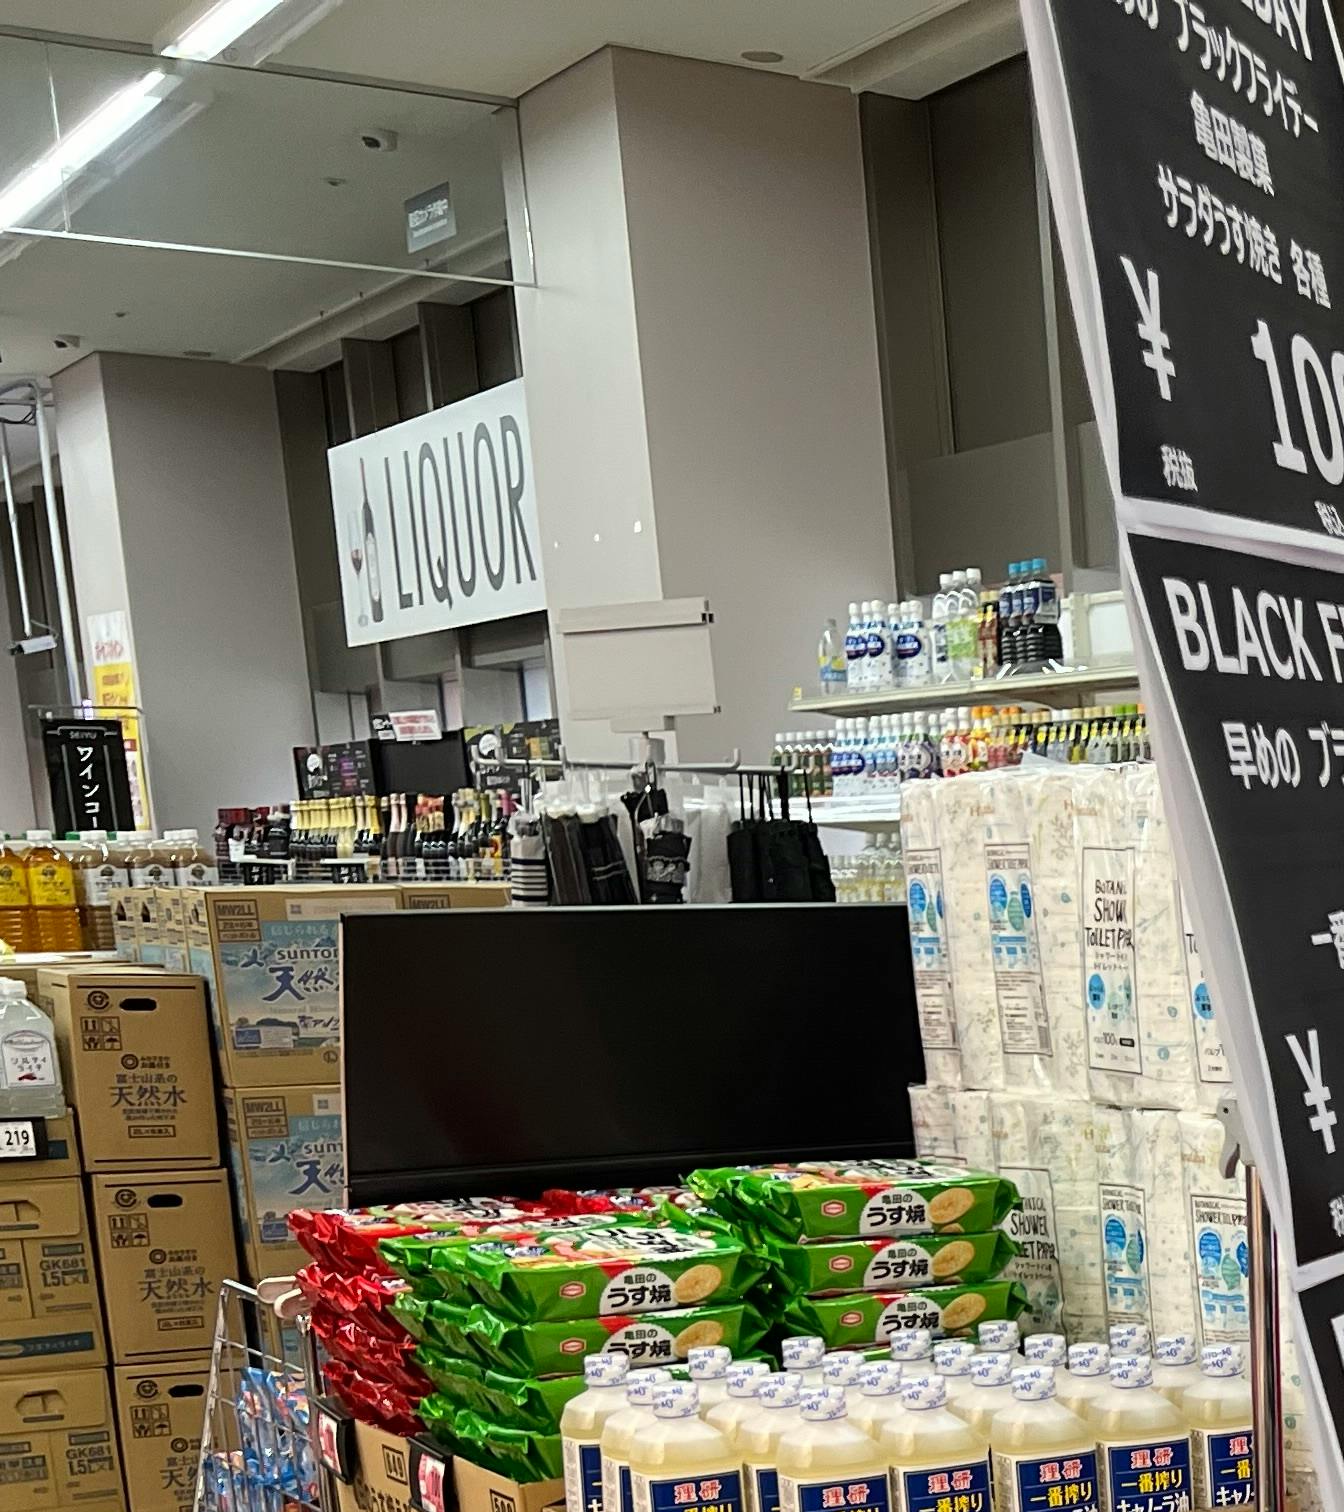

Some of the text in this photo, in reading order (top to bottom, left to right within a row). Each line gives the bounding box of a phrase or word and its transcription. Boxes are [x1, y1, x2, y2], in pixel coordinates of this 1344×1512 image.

[1190, 89, 1275, 197] 亀田製菓
[1157, 163, 1332, 309] サラダうす焼き 各種
[1121, 255, 1176, 401] ¥
[1160, 444, 1198, 492] 税抜
[384, 413, 537, 609] LIQUOR
[1162, 576, 1322, 682] BLACK
[1222, 721, 1301, 788] 早めの
[76, 745, 101, 829] ワインコー
[110, 1085, 188, 1108] 天然水
[1285, 1029, 1337, 1154] ¥
[4, 1129, 30, 1146] 219
[881, 1193, 913, 1204] 亀田の
[866, 1206, 926, 1226] うす焼
[887, 1247, 918, 1259] 亀田の
[623, 1273, 657, 1285] 亀田の
[872, 1259, 929, 1279] うす焼
[137, 1277, 216, 1301] 天然水
[606, 1284, 673, 1308] うす焼
[896, 1301, 928, 1313] 亀田の
[674, 1480, 722, 1504] 理研
[928, 1470, 972, 1494] 理研
[1030, 1480, 1092, 1507] 一番搾り
[1121, 1469, 1183, 1494] 一番搾り
[822, 1483, 870, 1508] 理研
